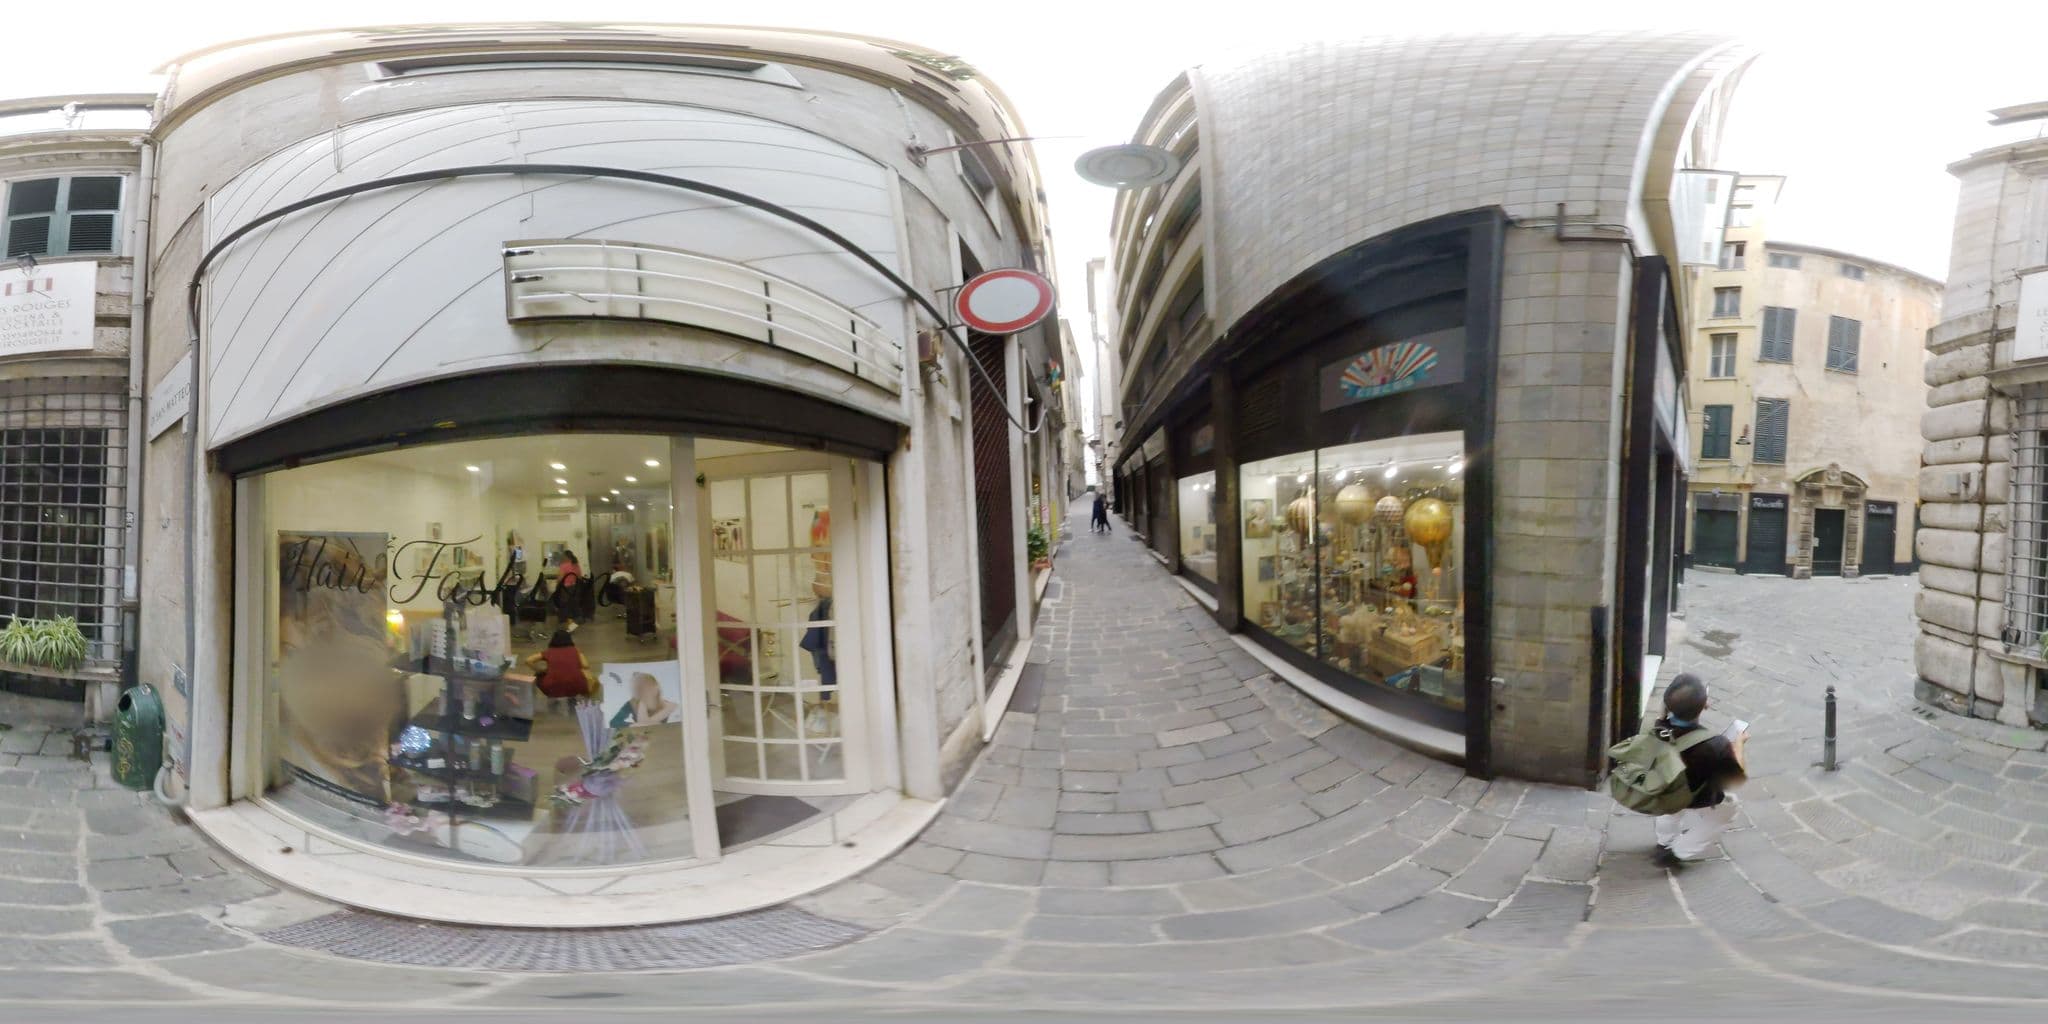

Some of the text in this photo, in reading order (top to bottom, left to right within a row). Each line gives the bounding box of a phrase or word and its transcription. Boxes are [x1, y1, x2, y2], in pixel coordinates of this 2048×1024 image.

[13, 299, 70, 312] ROUGES
[166, 382, 191, 408] MATTEO
[283, 534, 620, 607] Hair Fashion
